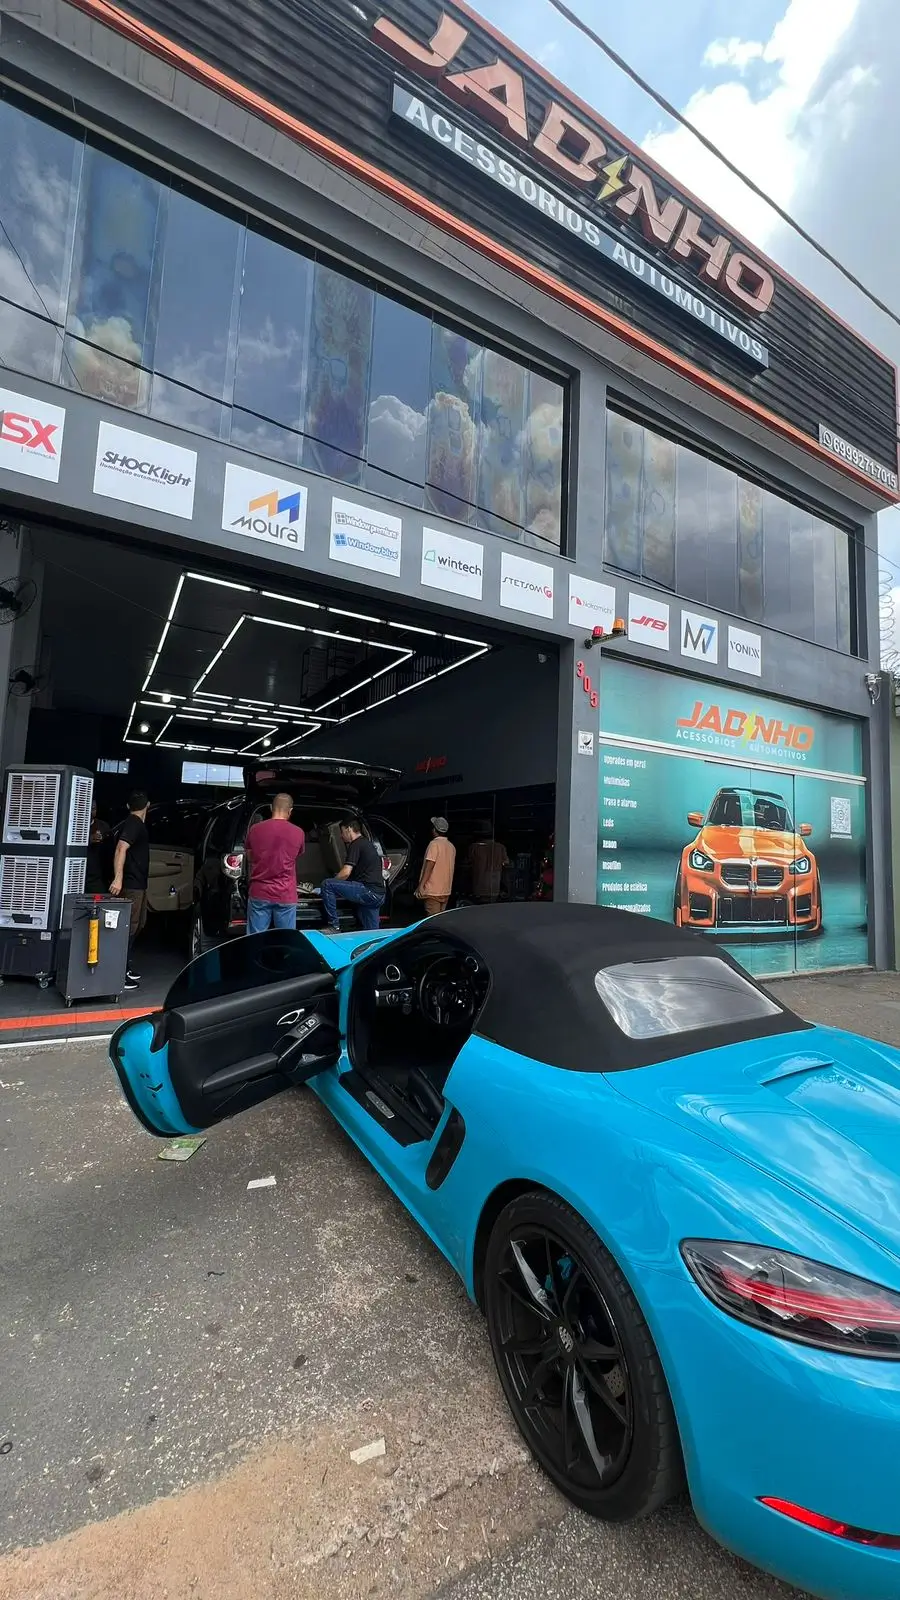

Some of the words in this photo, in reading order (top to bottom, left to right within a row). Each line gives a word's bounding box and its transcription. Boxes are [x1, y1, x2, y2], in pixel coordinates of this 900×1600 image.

[405, 97, 601, 247] ACESSORIOS
[613, 242, 764, 361] AUTOMOTIVOS
[437, 555, 482, 576] wintech
[576, 660, 599, 708] 305
